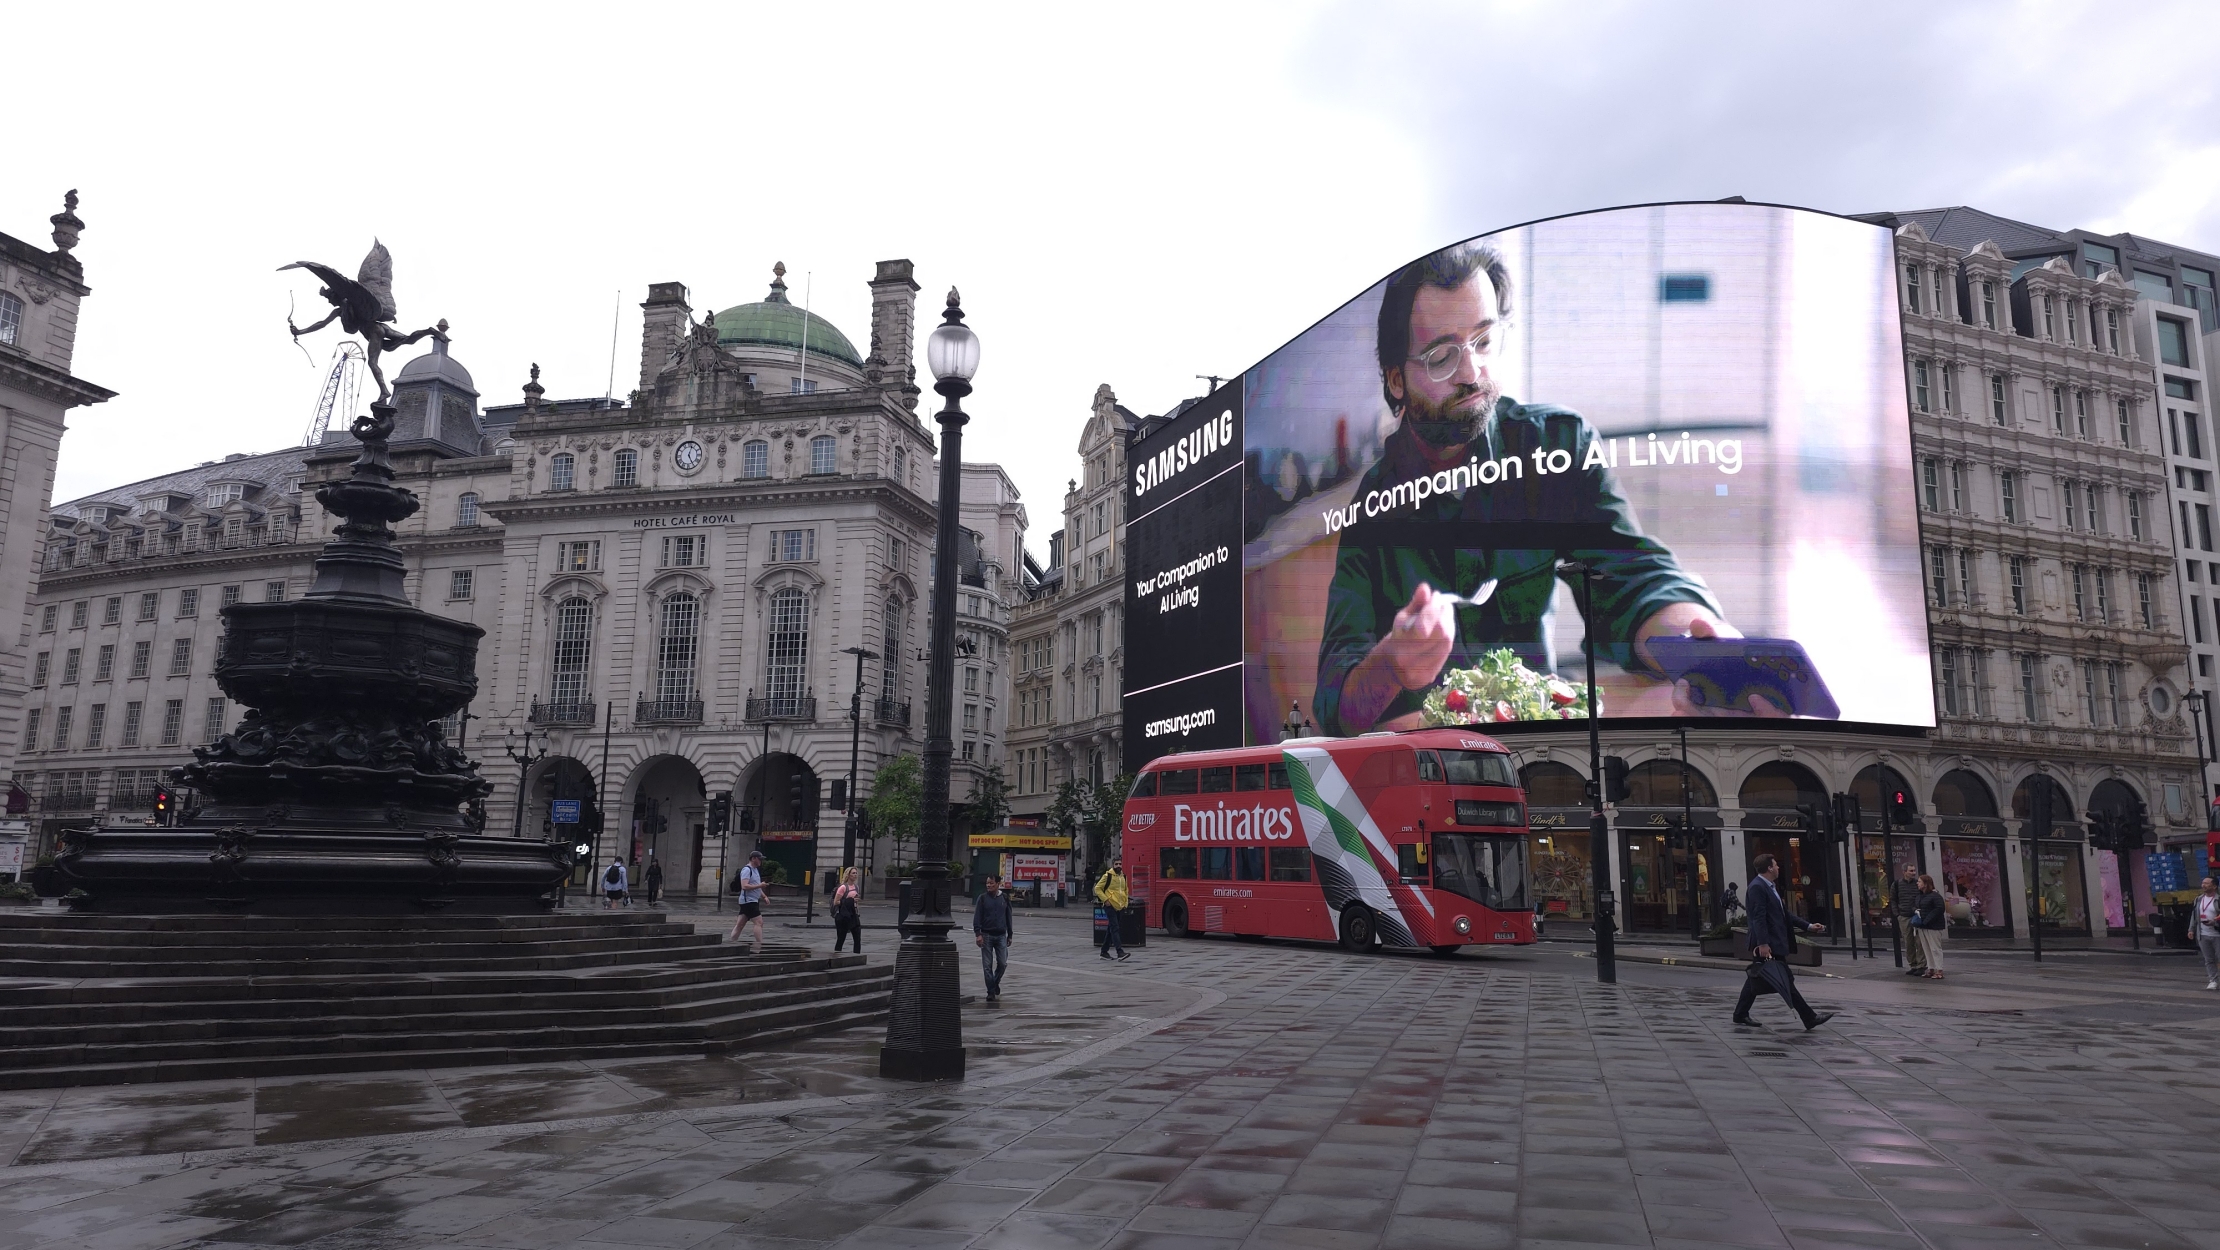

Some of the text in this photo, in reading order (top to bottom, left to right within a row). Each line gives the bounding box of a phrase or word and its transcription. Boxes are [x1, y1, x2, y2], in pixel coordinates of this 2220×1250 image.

[1134, 409, 1233, 497] SAMSUNG
[1321, 431, 1744, 535] Your Companion to AI Living
[633, 514, 736, 528] HOTEL CAFÉ ROYAL
[1136, 545, 1229, 599] Your Companion to
[1159, 584, 1199, 615] AI Living
[1145, 708, 1215, 738] samsung.com
[1460, 739, 1499, 751] Emirates
[1131, 813, 1155, 825] FLY BETTER
[1457, 807, 1497, 819] Dulwich Library
[1505, 807, 1517, 822] 12
[1529, 814, 1558, 825] Lindt
[1174, 801, 1293, 841] Emirates
[1771, 815, 1799, 828] Lind
[1958, 822, 1982, 834] Lindt
[1213, 886, 1253, 898] emirates.com
